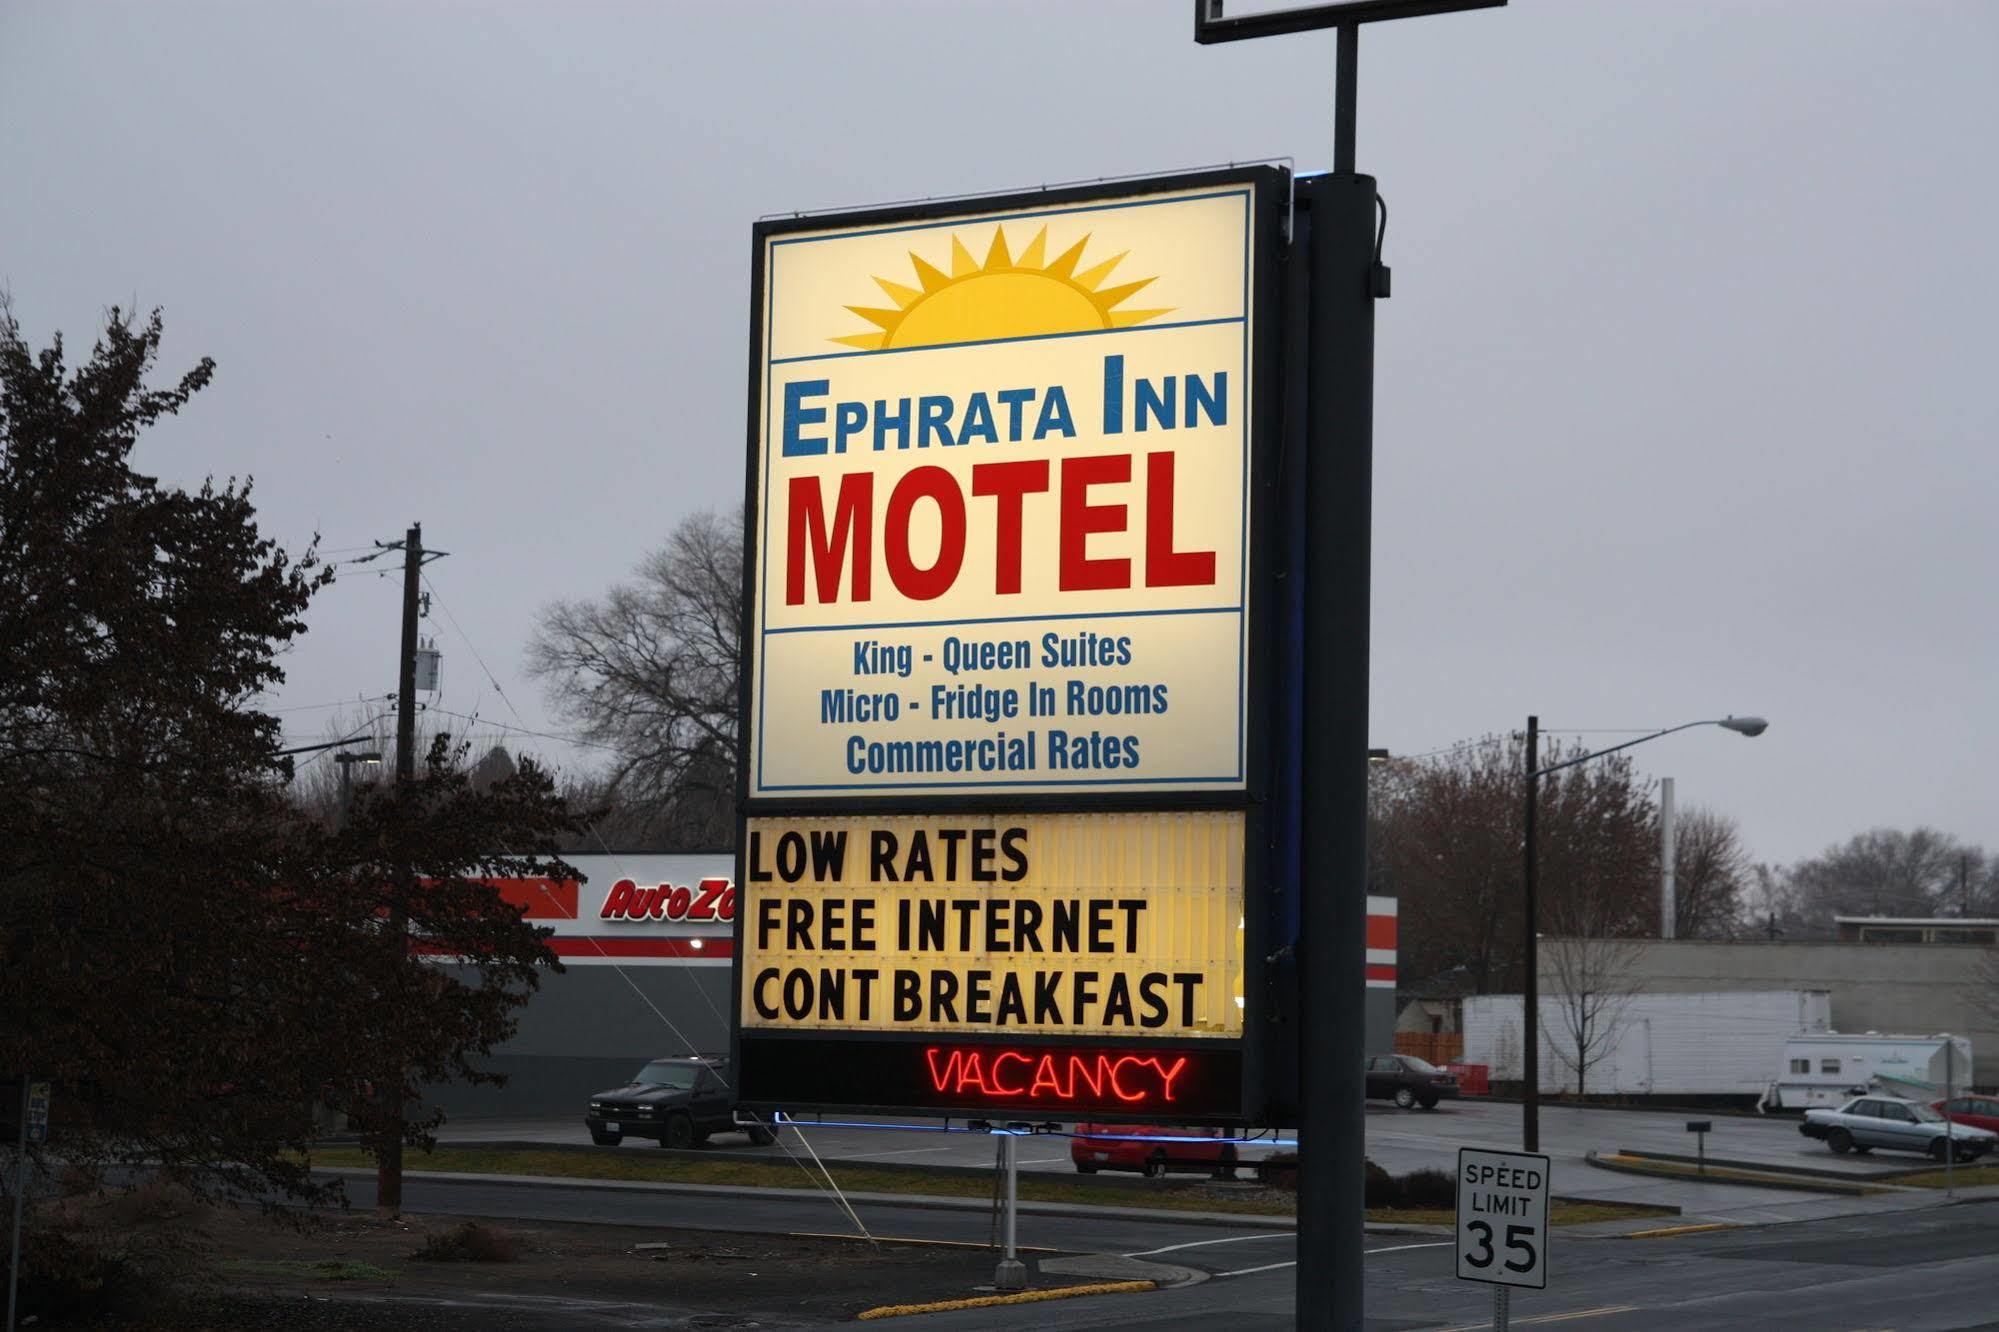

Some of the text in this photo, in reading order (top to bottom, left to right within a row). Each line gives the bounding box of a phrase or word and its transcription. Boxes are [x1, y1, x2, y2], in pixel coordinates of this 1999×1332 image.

[782, 354, 1228, 457] EPHRATA INN
[786, 451, 1217, 606] MOTEL
[853, 641, 913, 678] King
[943, 636, 1031, 675] Queen
[1041, 631, 1132, 668] Suites
[821, 689, 900, 724] Micro
[931, 684, 1019, 723] Fridge
[1029, 681, 1056, 717] In
[1067, 680, 1169, 716] Rooms
[847, 729, 1140, 775] Commercial Rates
[749, 827, 1029, 883] LOW RATES
[757, 898, 1147, 954] FREE INTERNET
[752, 967, 1203, 1028] CONT BREAKFAST
[926, 1049, 1187, 1101] VACANCY
[1465, 1164, 1541, 1190] SPEED
[1472, 1192, 1531, 1217] LIMIT
[1464, 1220, 1536, 1273] 35
